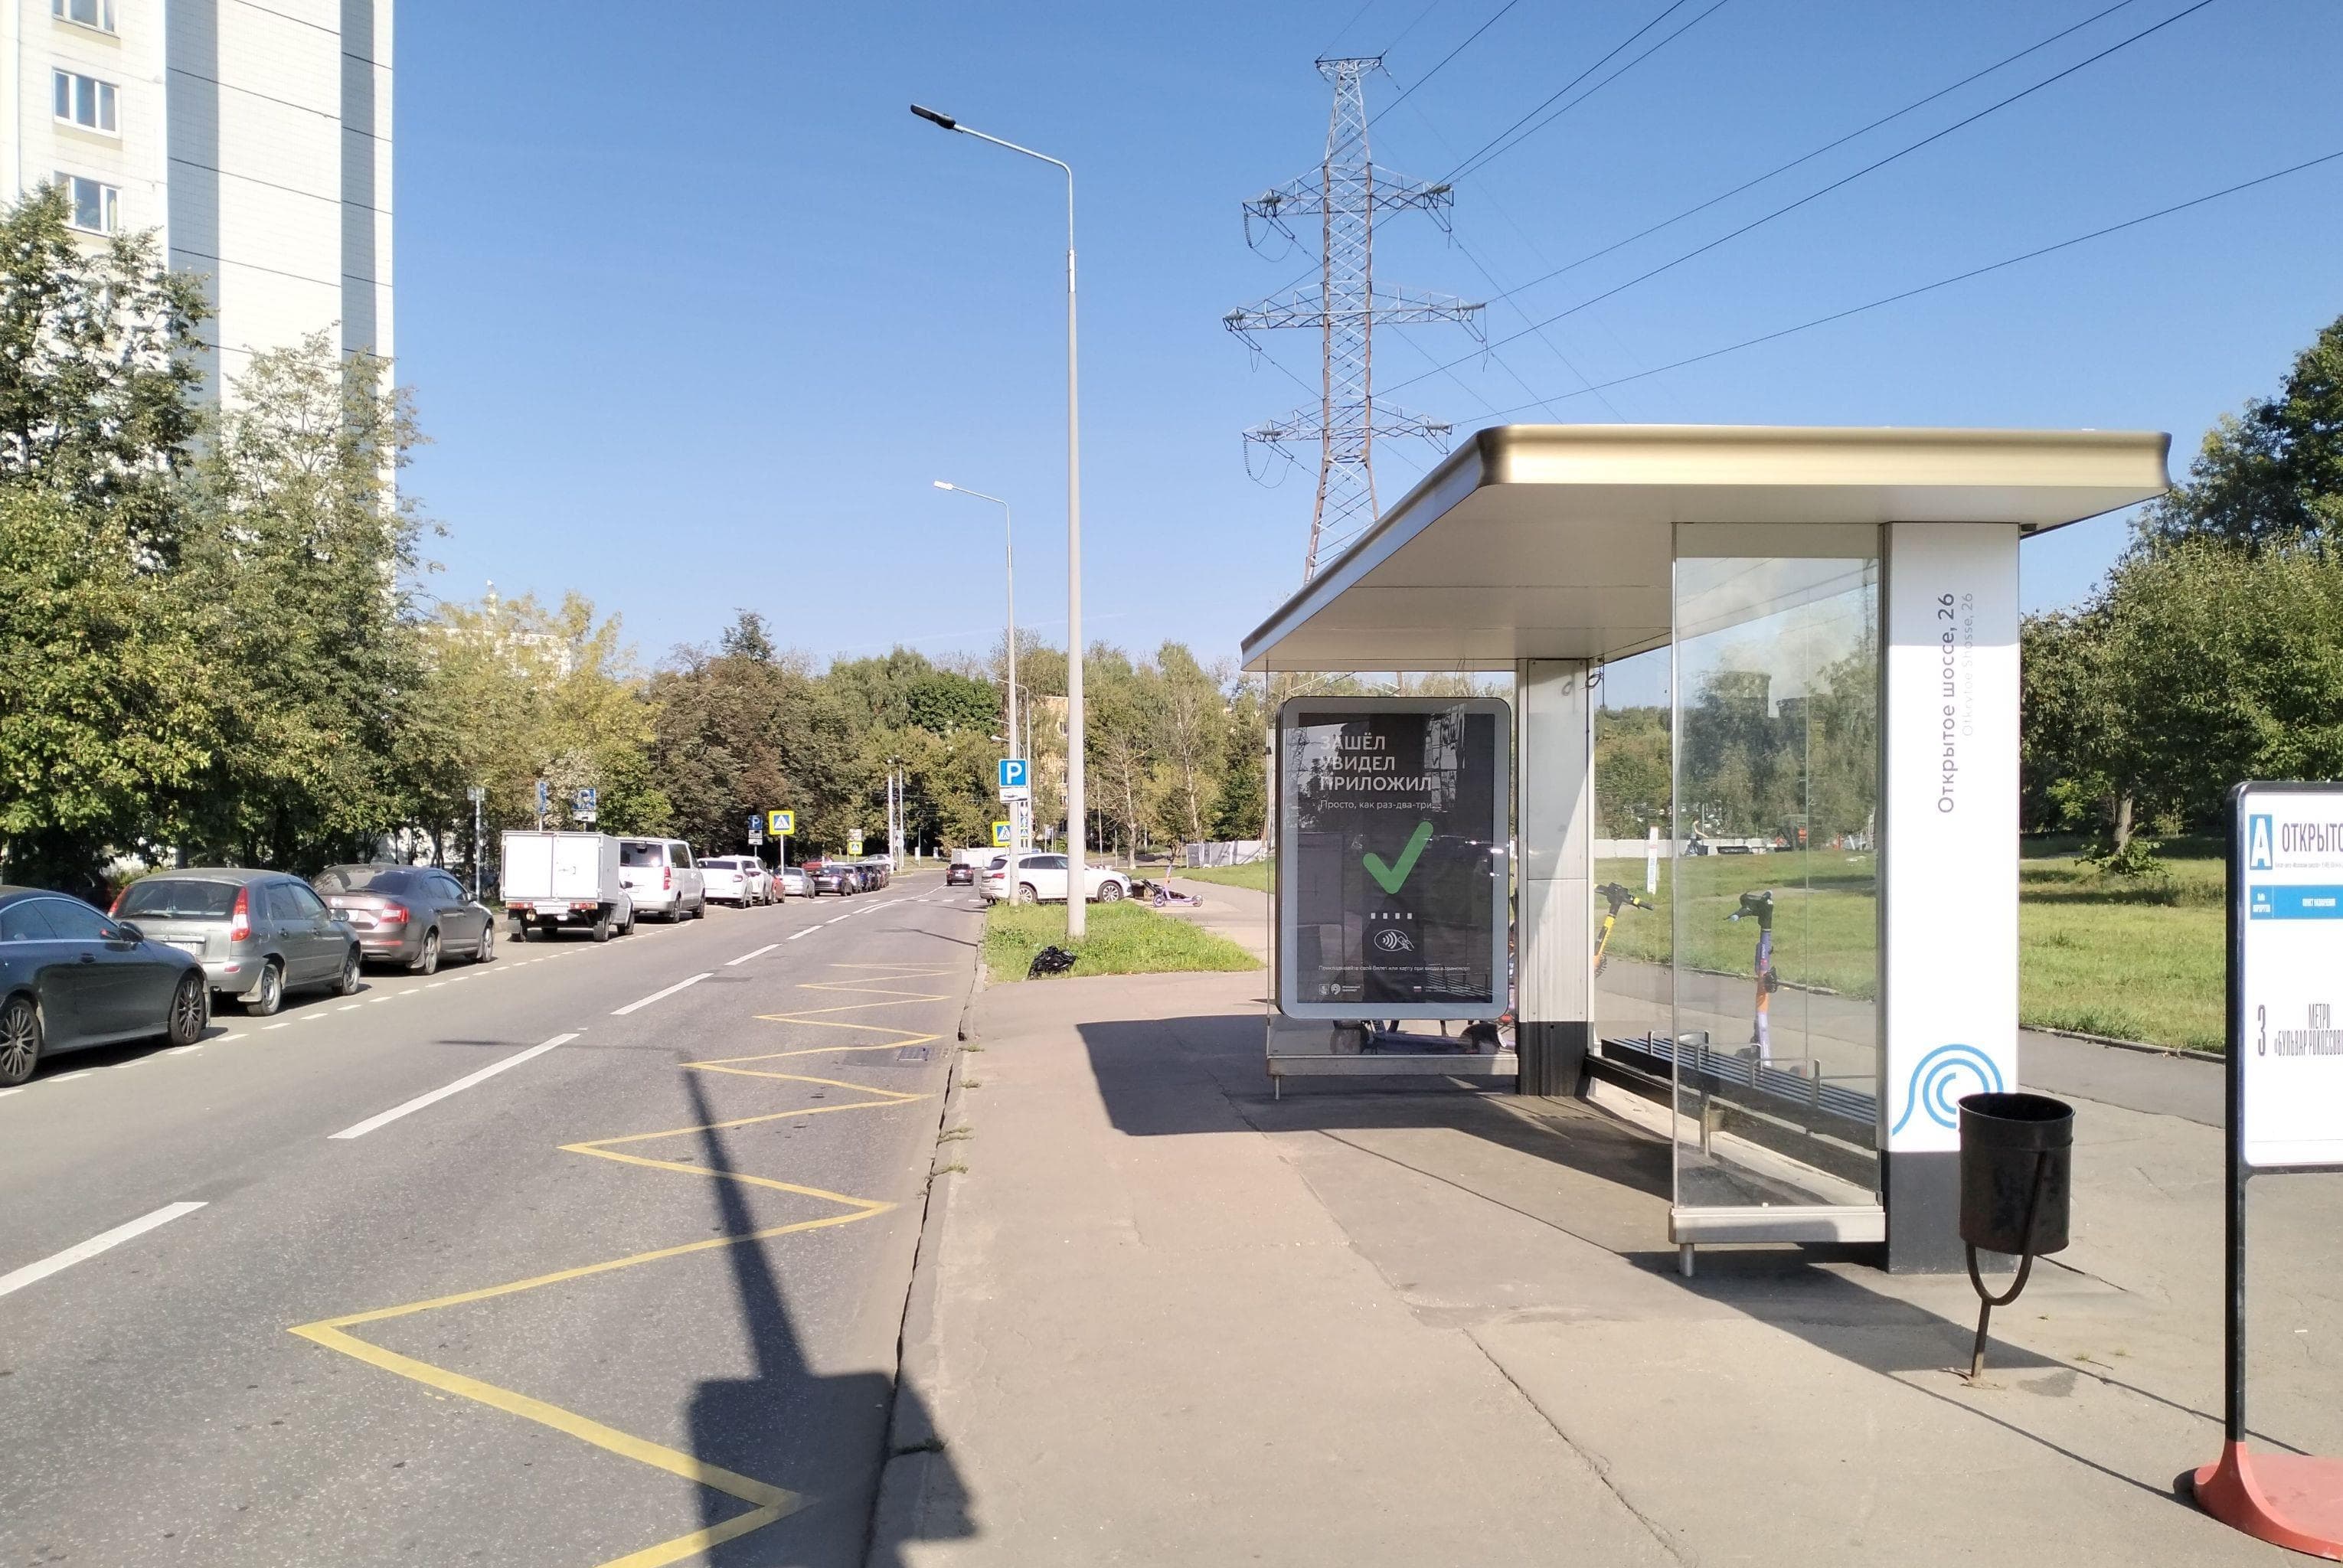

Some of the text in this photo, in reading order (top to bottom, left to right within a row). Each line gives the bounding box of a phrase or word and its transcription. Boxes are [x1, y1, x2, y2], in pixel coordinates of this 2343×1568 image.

[1961, 593, 1972, 611] 26
[1938, 593, 1958, 813] Открытое шоссе, 26
[1320, 733, 1385, 750] ЗАШЁЛ
[1006, 762, 1023, 784] P
[1321, 756, 1395, 773] УВИДЕЛ
[1320, 776, 1431, 791] ПРИЛОЖИЛ
[752, 817, 760, 828] P
[2309, 1003, 2330, 1029] МЕТРО
[2257, 1004, 2266, 1057] 3
